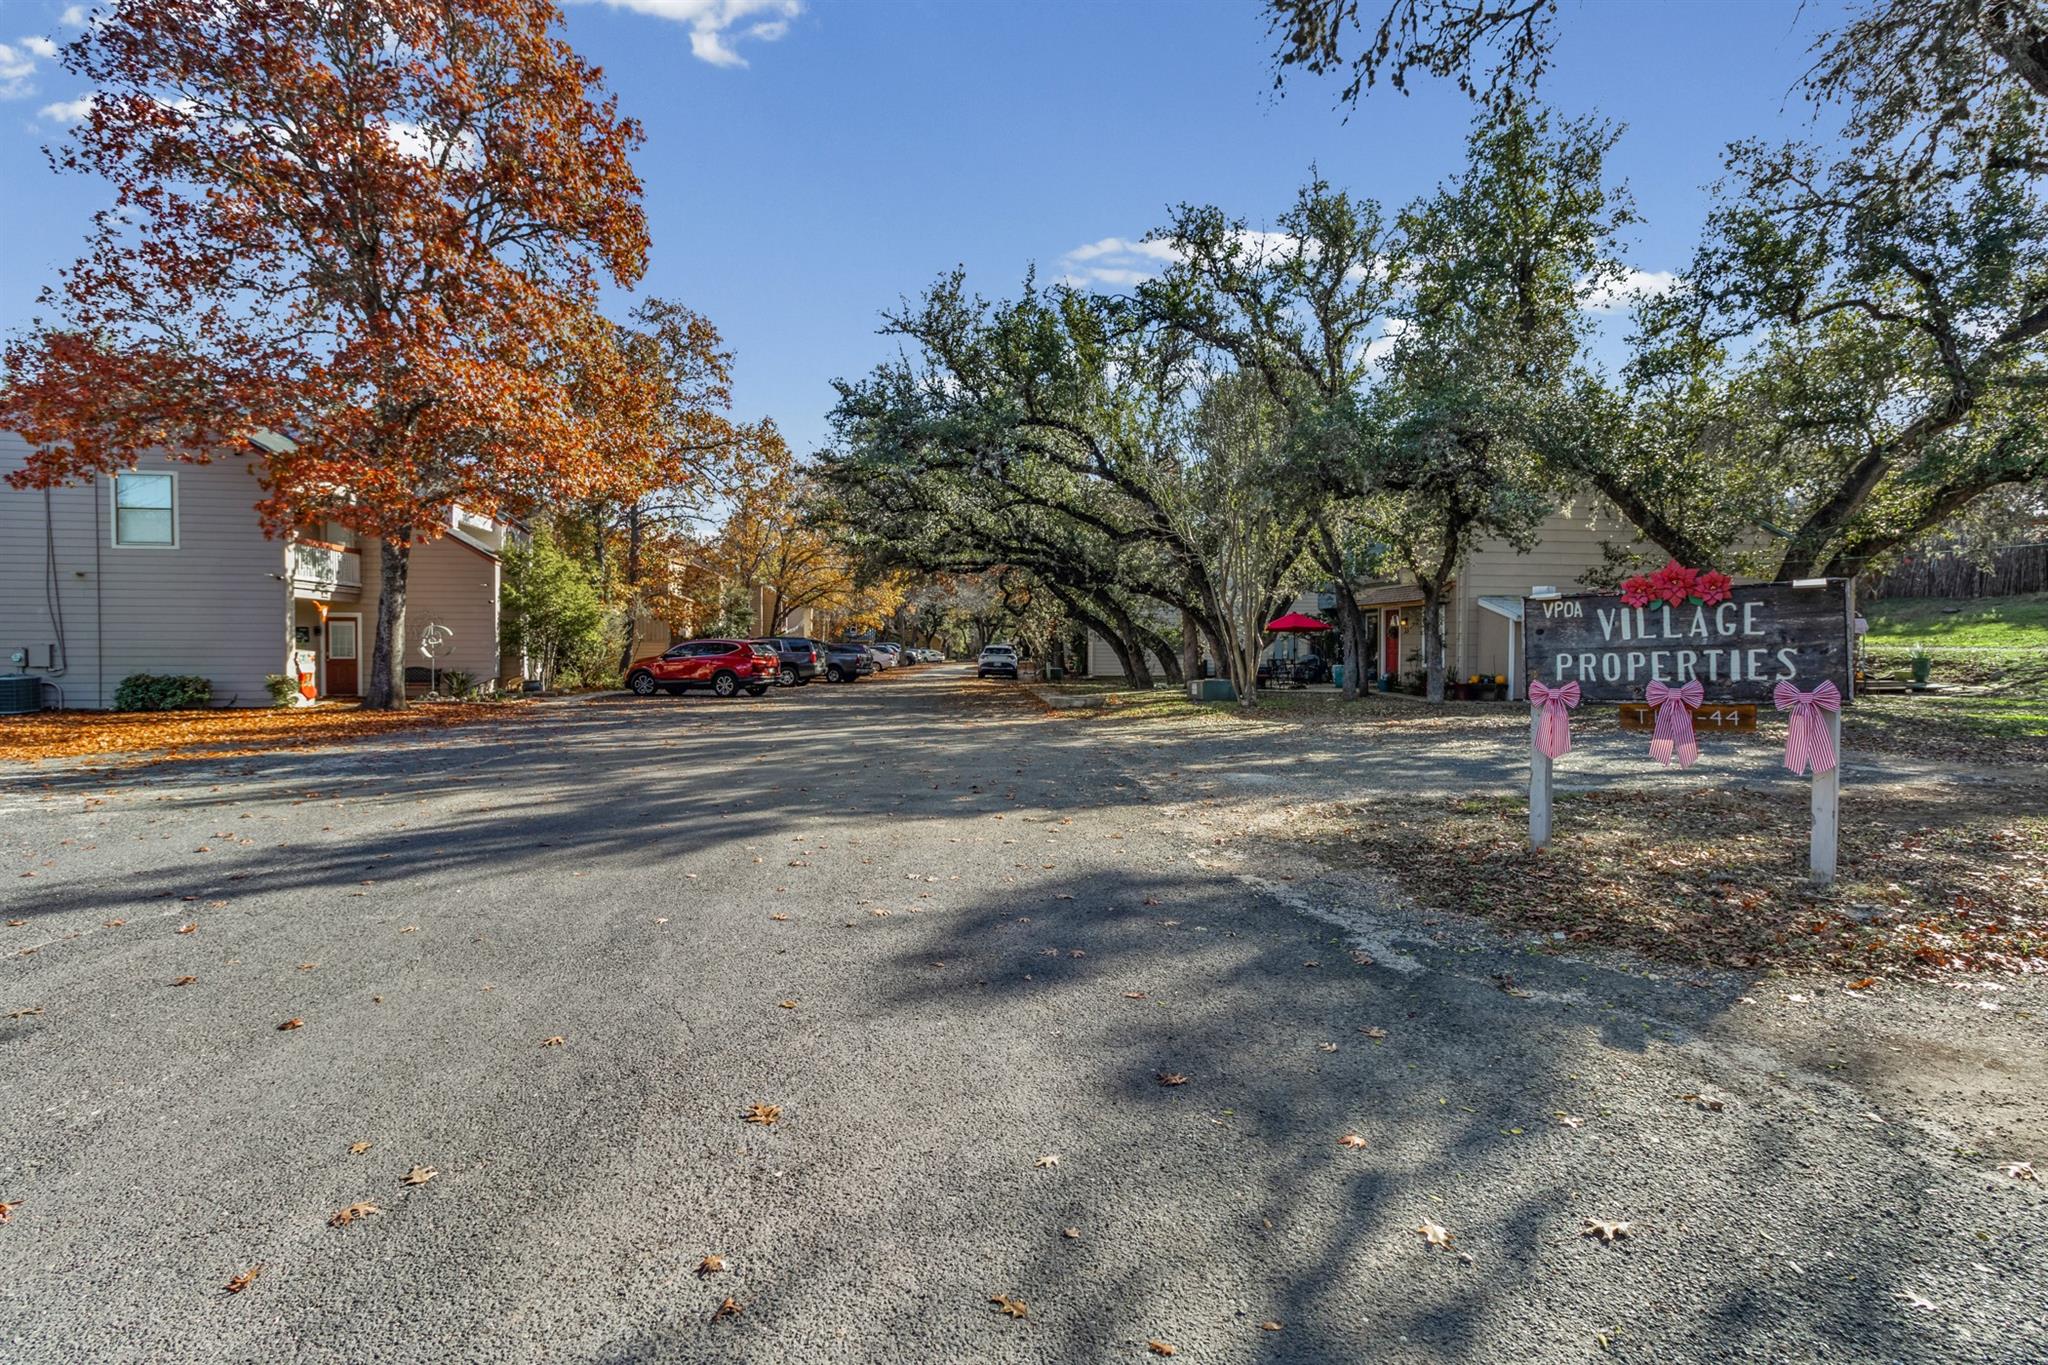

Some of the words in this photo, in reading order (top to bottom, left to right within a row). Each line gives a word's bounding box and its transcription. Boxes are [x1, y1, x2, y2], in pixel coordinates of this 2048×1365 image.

[1543, 602, 1583, 618] VPOA
[1597, 602, 1765, 641] VILLAGE
[1556, 649, 1798, 682] PROPERTIES
